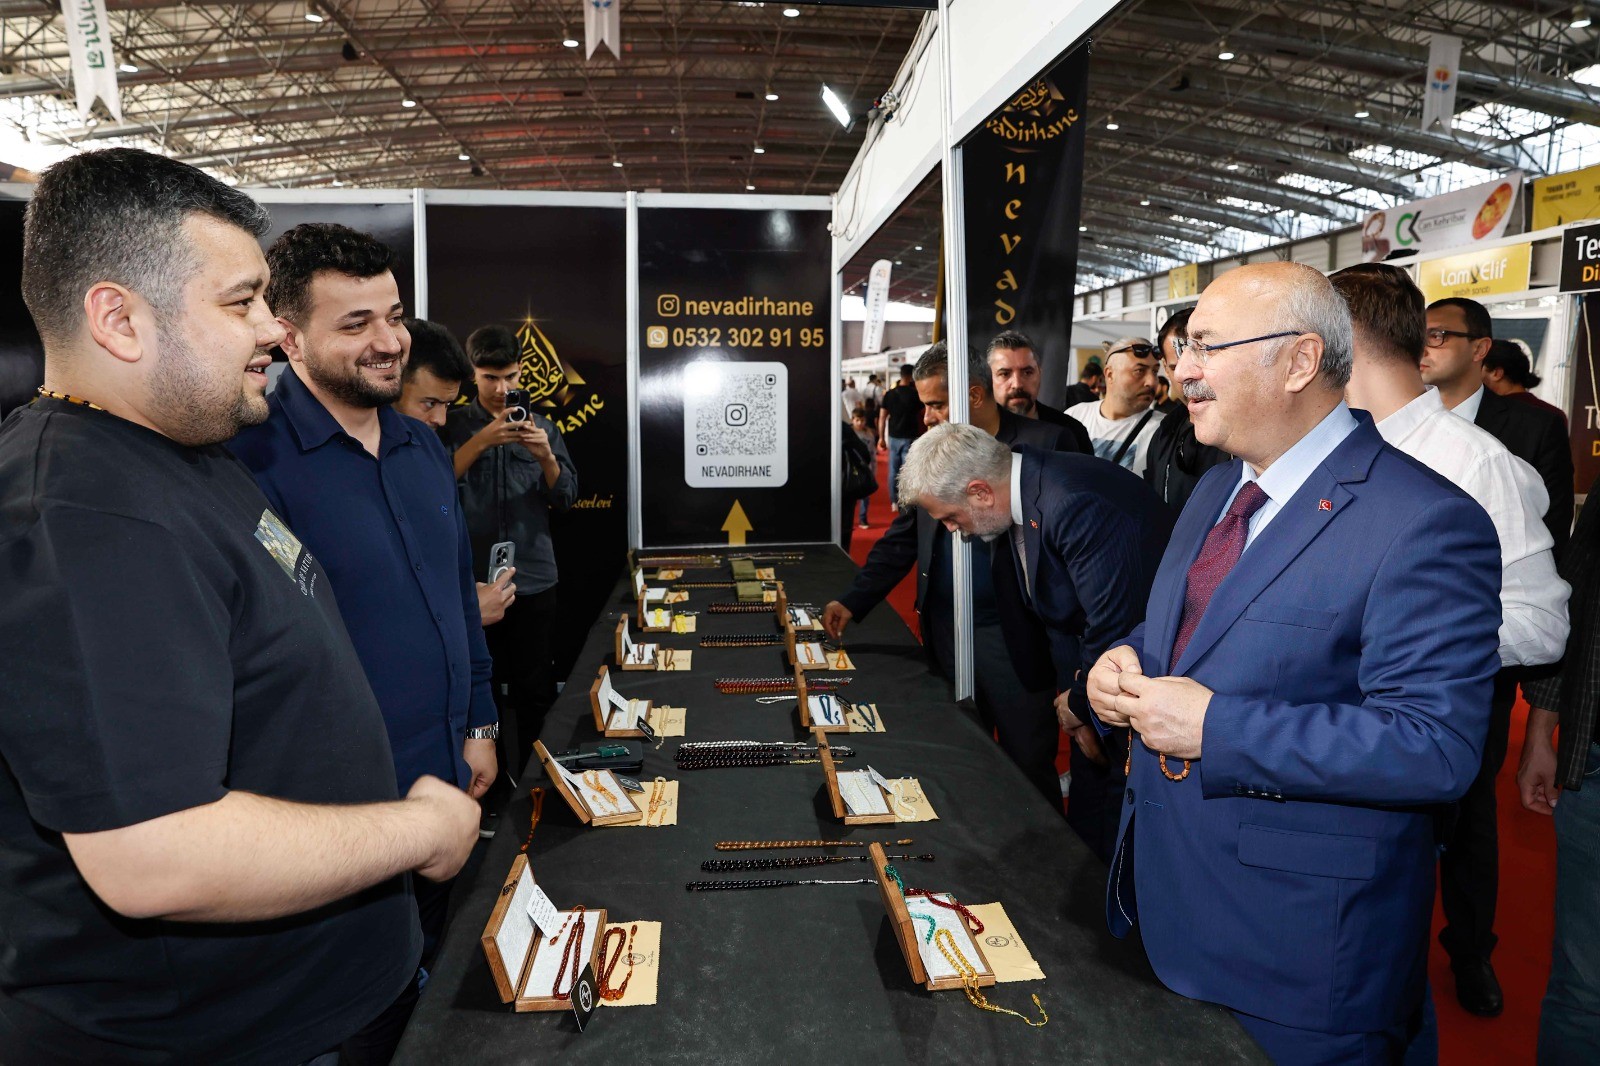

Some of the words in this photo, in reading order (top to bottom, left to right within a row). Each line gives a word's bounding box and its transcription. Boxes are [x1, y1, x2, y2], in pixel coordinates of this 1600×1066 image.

[1441, 268, 1470, 287] Lam
[1480, 258, 1508, 281] Elif
[685, 296, 814, 316] nevadirhane
[672, 327, 721, 347] 0532
[727, 327, 764, 347] 302
[769, 327, 792, 347] 91
[800, 327, 824, 347] 95
[701, 465, 772, 478] NEVADIRHANE
